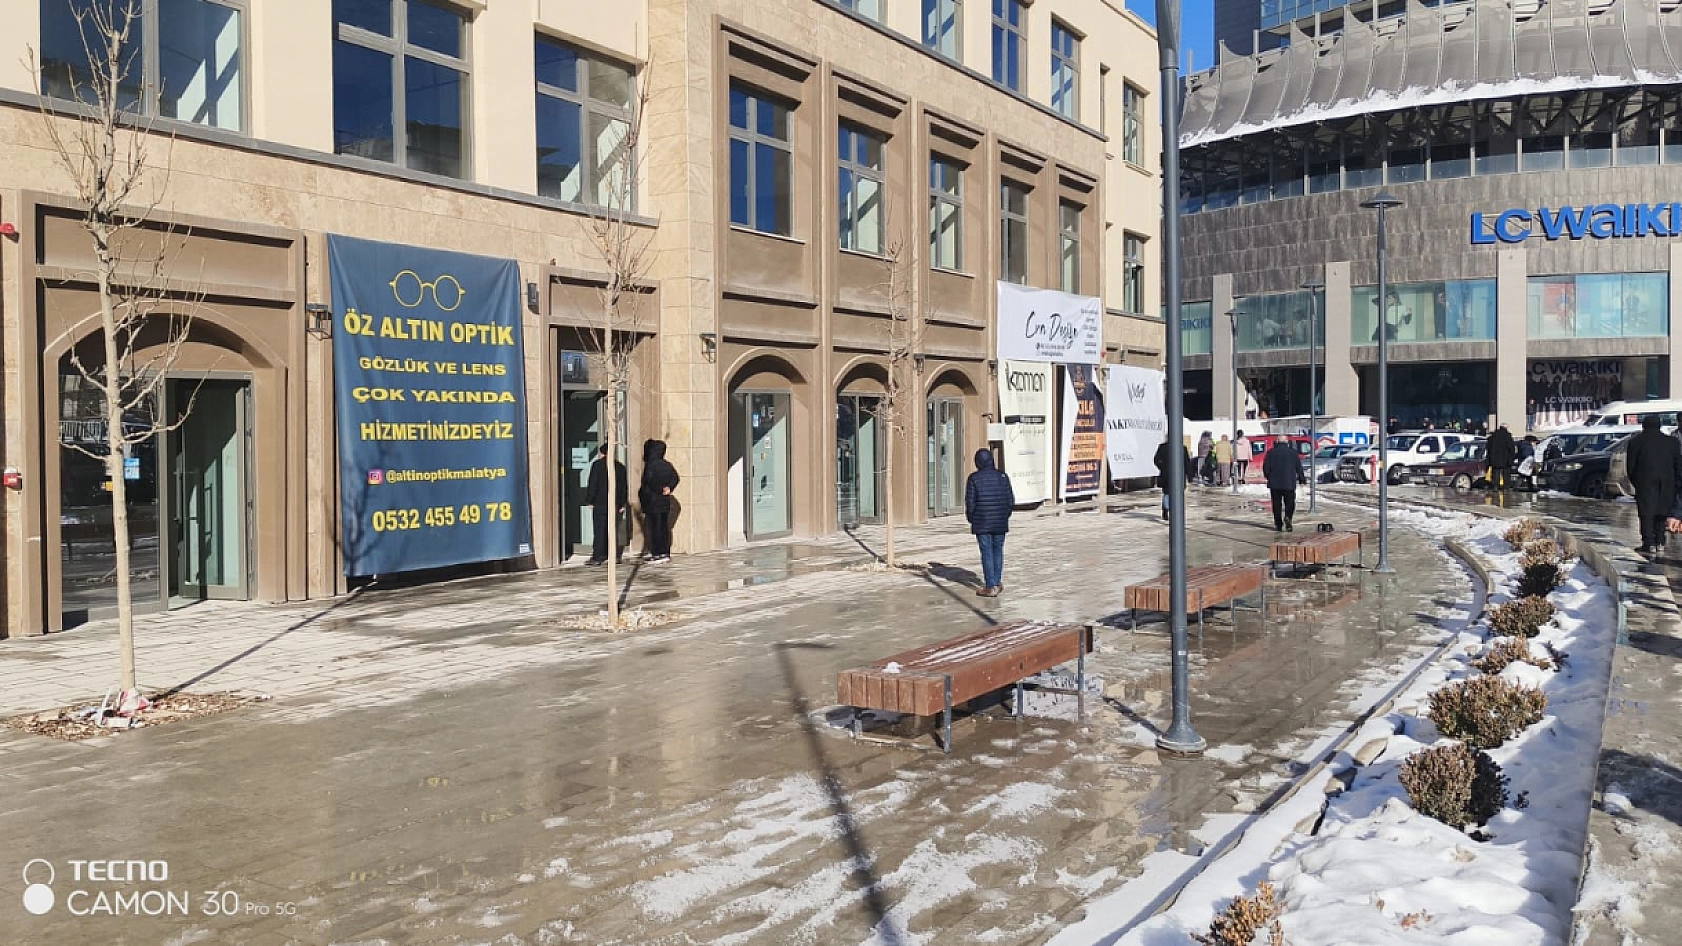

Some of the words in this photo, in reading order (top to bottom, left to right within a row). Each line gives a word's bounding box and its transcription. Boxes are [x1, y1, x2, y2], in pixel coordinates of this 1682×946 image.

[1471, 208, 1533, 244] LC
[344, 307, 376, 336] ÖZ
[380, 316, 444, 342] ALTIN
[450, 321, 515, 346] OPTİK
[360, 355, 430, 373] GÖZLÜK
[433, 361, 458, 374] VE
[462, 362, 507, 376] LENS
[352, 386, 405, 404] ÇOK
[411, 389, 516, 404] YAKINDA
[360, 418, 514, 441] HİZMETİNİZDEYİZ
[385, 467, 507, 484] @altinoptikmalatya
[372, 508, 420, 532] 0532
[425, 506, 455, 527] 455
[459, 504, 481, 524] 49
[486, 501, 512, 522] 78
